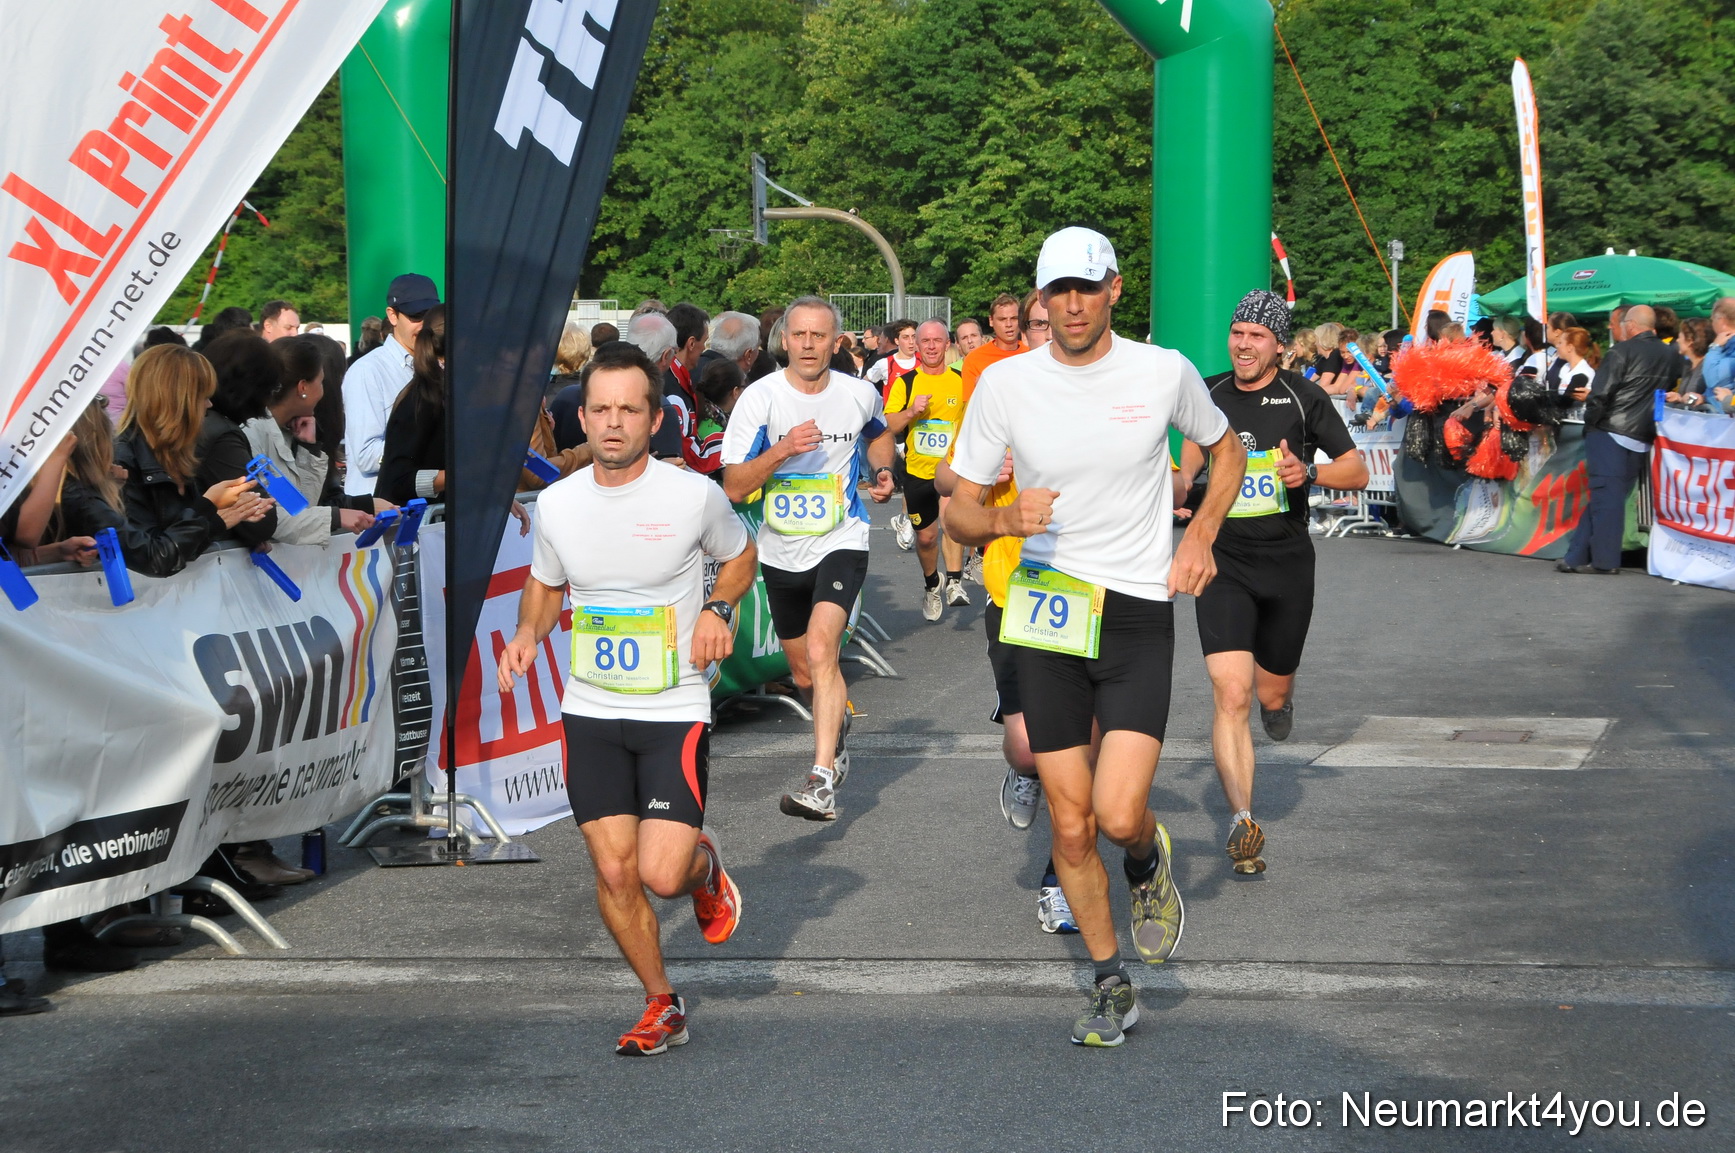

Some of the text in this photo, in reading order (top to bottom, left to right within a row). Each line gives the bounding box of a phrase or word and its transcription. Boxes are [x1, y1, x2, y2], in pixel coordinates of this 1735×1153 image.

[1, 13, 244, 306] XL Print
[1546, 283, 1612, 292] ammsbräu
[918, 431, 947, 448] 769
[1241, 475, 1275, 499] 86
[774, 494, 826, 519] 933
[1028, 590, 1069, 629] 79
[1023, 625, 1058, 638] Christian
[595, 637, 640, 671] 80
[586, 670, 623, 680] Christian
[193, 615, 344, 763] swn
[648, 798, 670, 810] asics
[61, 843, 93, 868] die
[93, 827, 171, 861] verbinden
